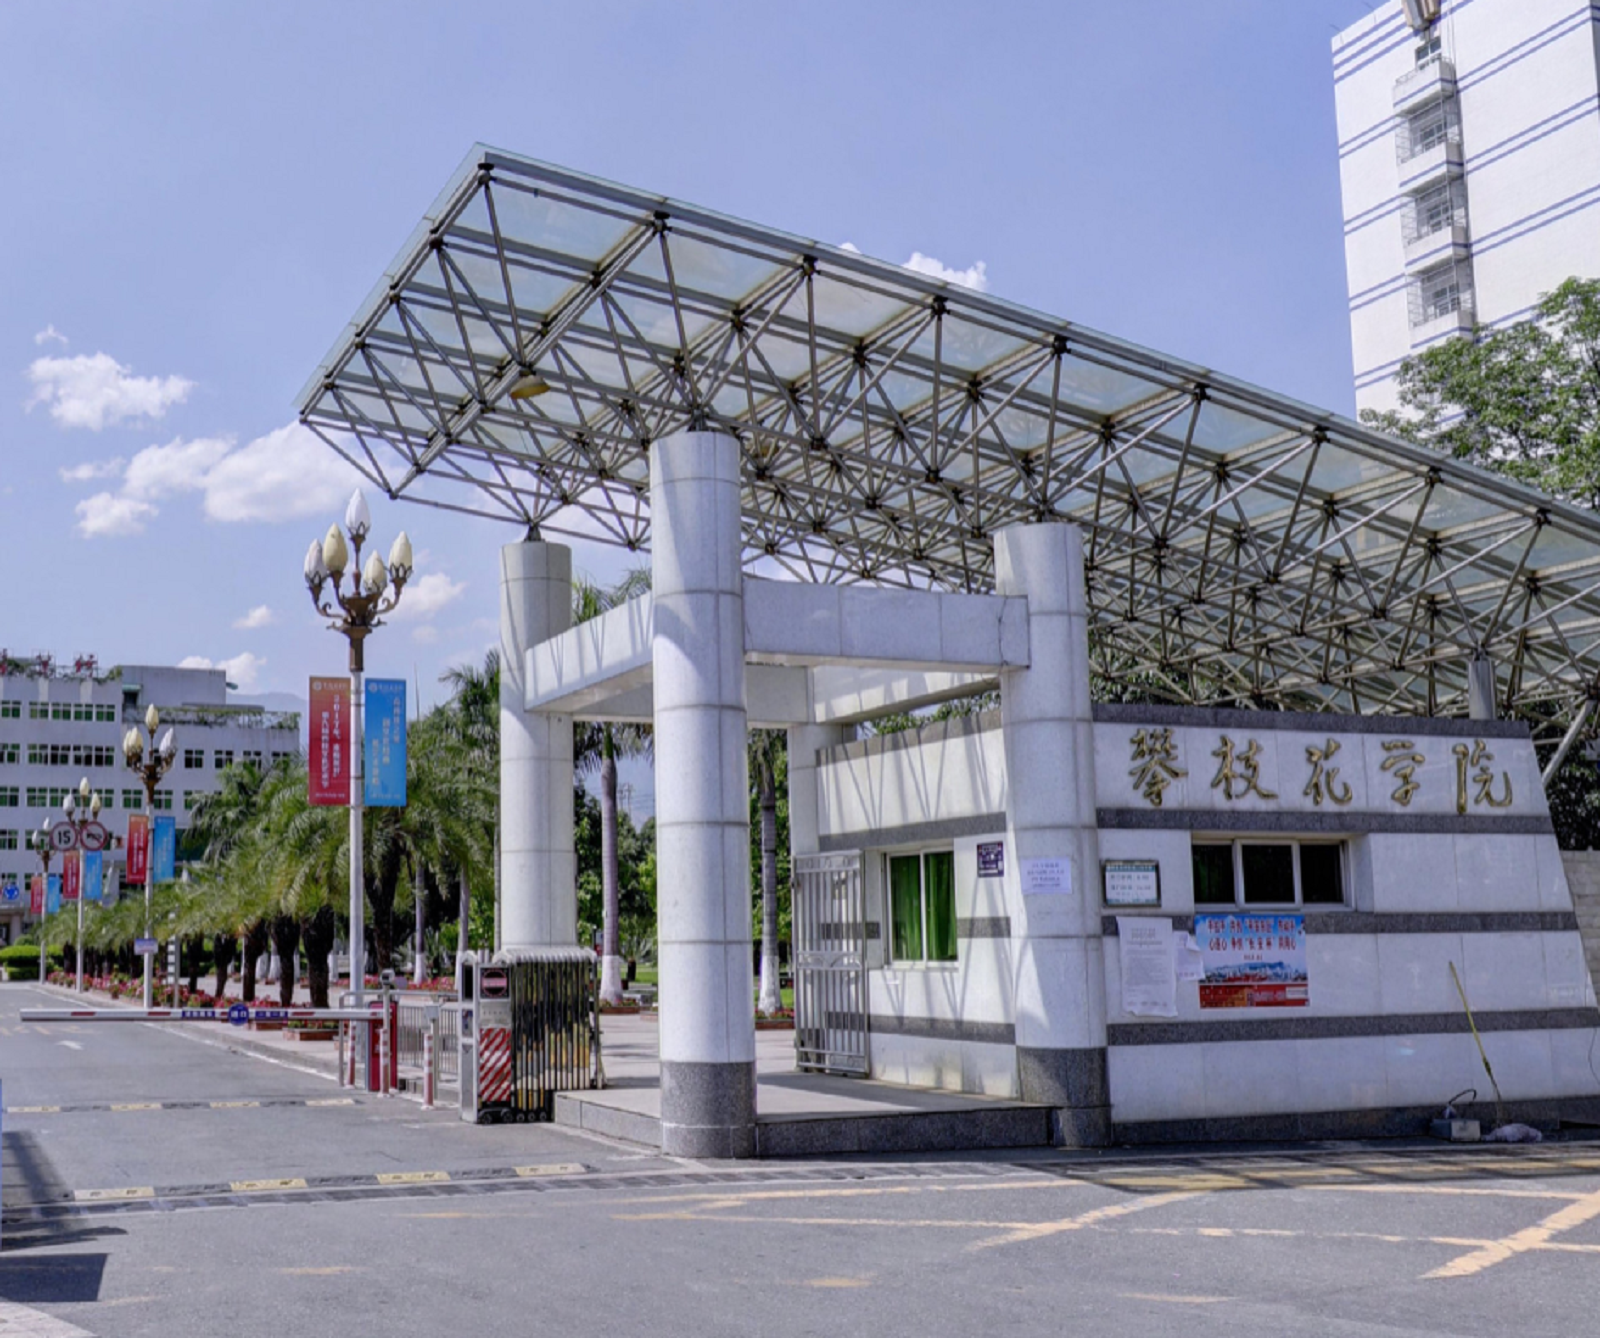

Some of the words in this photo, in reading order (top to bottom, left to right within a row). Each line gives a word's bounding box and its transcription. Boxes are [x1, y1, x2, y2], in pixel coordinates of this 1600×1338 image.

[1130, 727, 1513, 814] 攀枝花学院
[58, 830, 71, 845] 15
